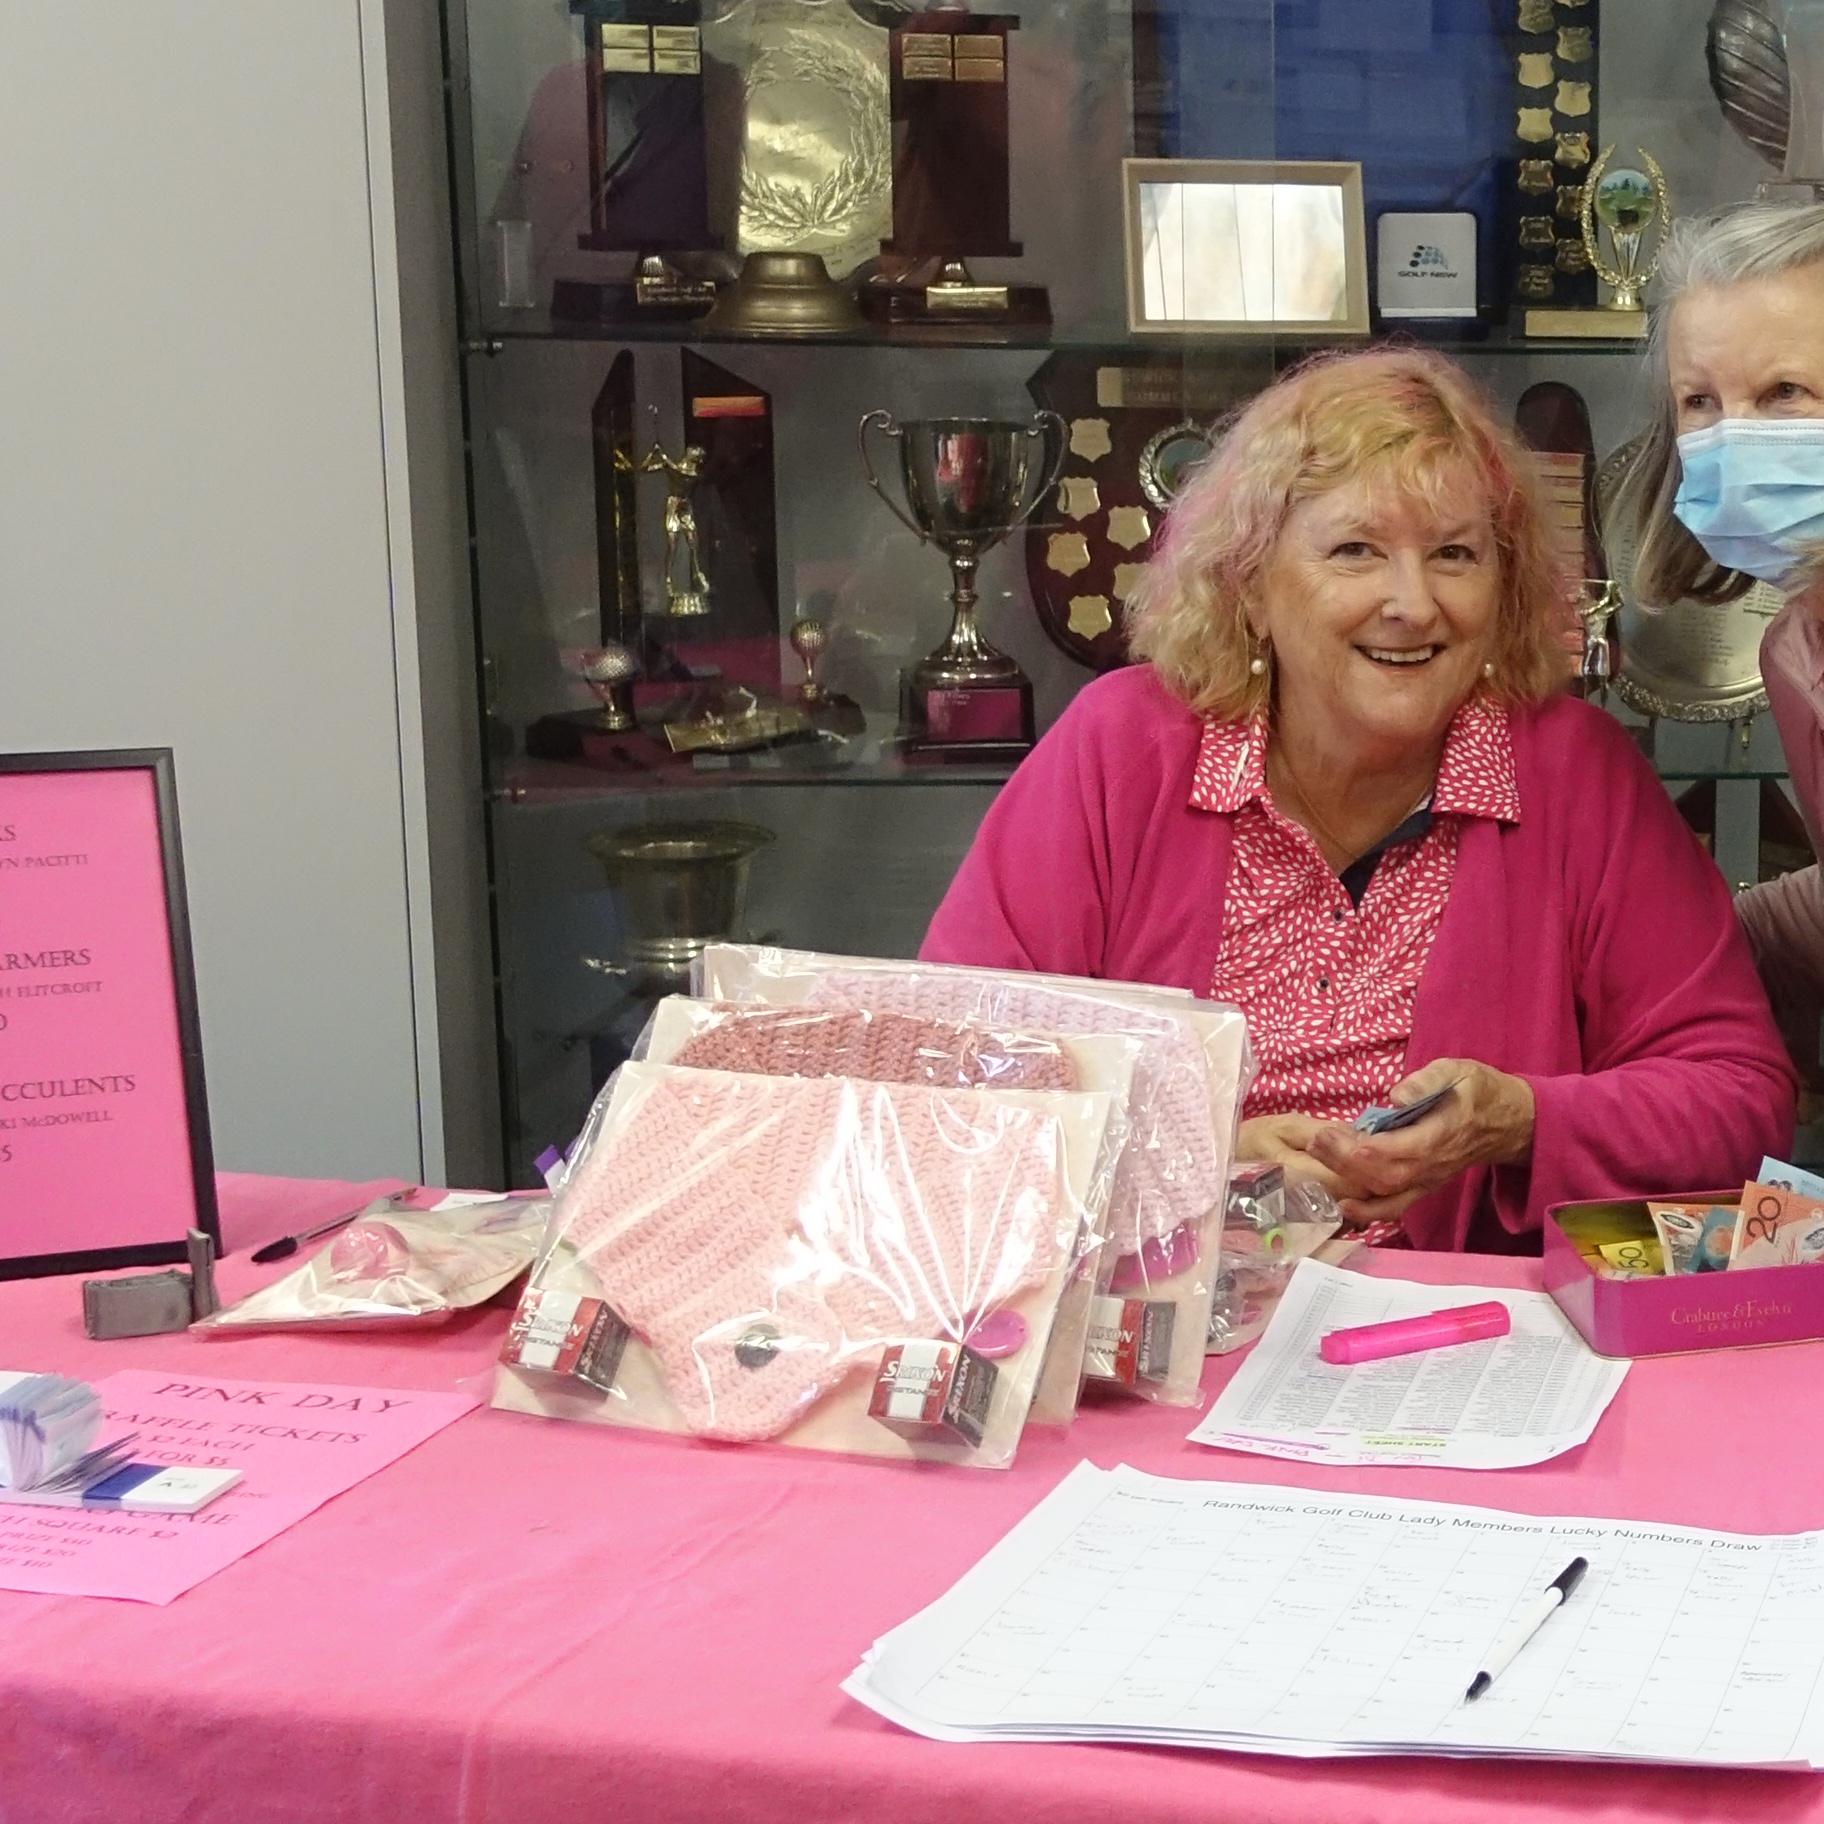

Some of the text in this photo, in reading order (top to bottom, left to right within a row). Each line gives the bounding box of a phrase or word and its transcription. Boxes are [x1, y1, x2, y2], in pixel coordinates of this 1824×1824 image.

[1398, 270, 1458, 279] GOLF NSW
[1, 1074, 136, 1102] CCULENTS
[1746, 1195, 1781, 1245] 20
[1671, 1306, 1730, 1325] Crabtree
[152, 1382, 413, 1414] PINK DAY
[228, 1422, 368, 1444] TICKETS
[1202, 1499, 1296, 1515] Randwick
[1302, 1506, 1343, 1517] Golf
[1348, 1508, 1393, 1522] Club
[1398, 1512, 1447, 1528] Lady
[1451, 1517, 1543, 1535] Members
[1550, 1525, 1608, 1538] Lucky
[1613, 1528, 1703, 1547] Numbers
[1709, 1539, 1762, 1553] Draw
